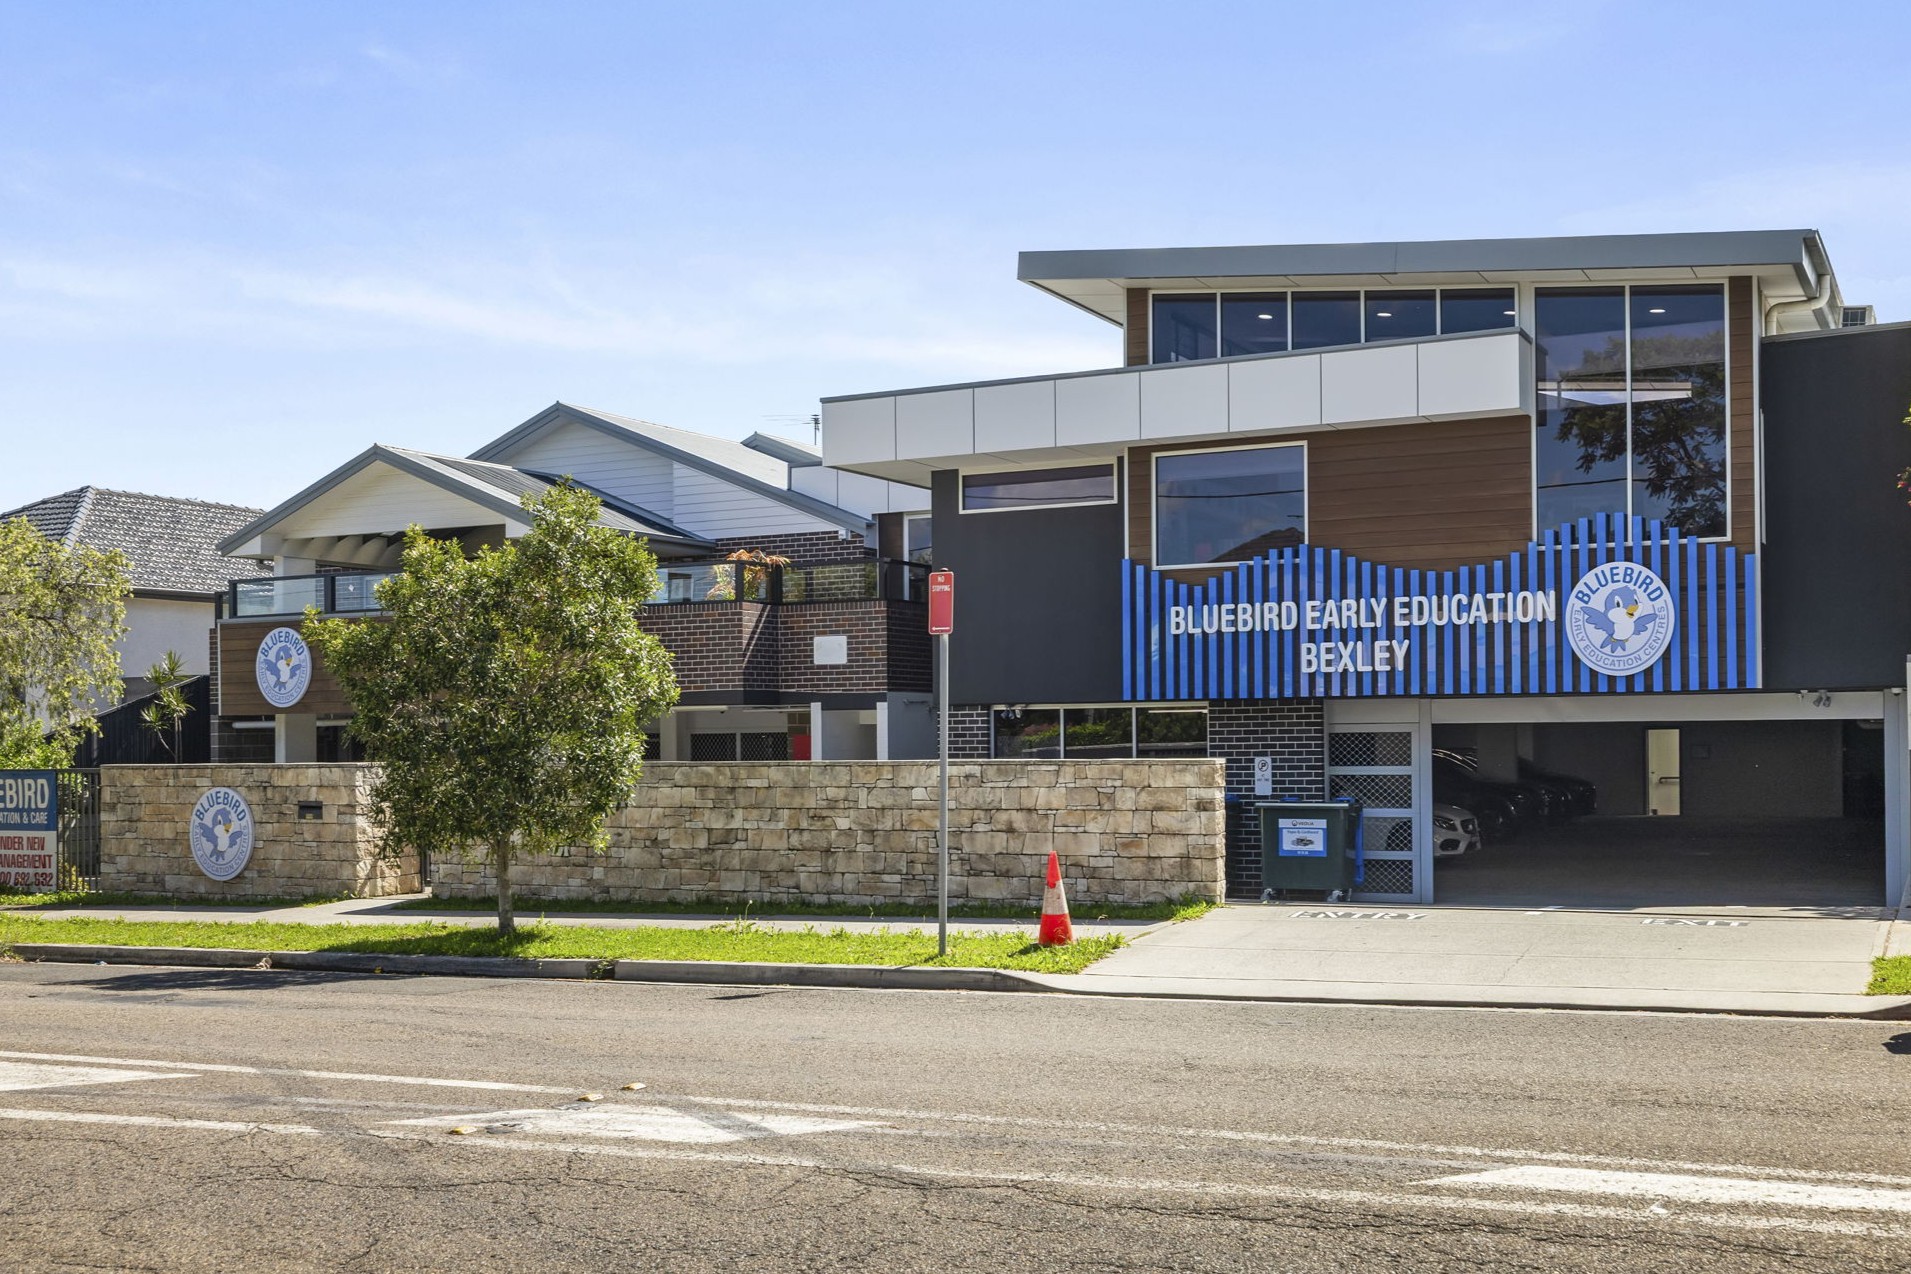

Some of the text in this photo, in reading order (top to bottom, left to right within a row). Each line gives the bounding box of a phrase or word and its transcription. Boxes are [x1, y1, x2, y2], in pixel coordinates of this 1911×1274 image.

[1575, 566, 1664, 605] BLUEBIRD
[1170, 590, 1556, 635] BLUEBIRD EARLY EDUCATION
[260, 631, 305, 657] BLUEBIRD
[1573, 606, 1667, 668] EARLY EDUCATION CENTRES
[1301, 639, 1410, 673] BEXLEY
[22, 812, 29, 824] &
[30, 812, 48, 824] CARE
[195, 791, 247, 821] BLUEBIRD
[27, 836, 45, 851] NEW
[198, 852, 235, 874] EDUCATION
[34, 872, 54, 887] 632
[1289, 910, 1427, 920] ENTRY
[1640, 918, 1750, 927] EXIT
